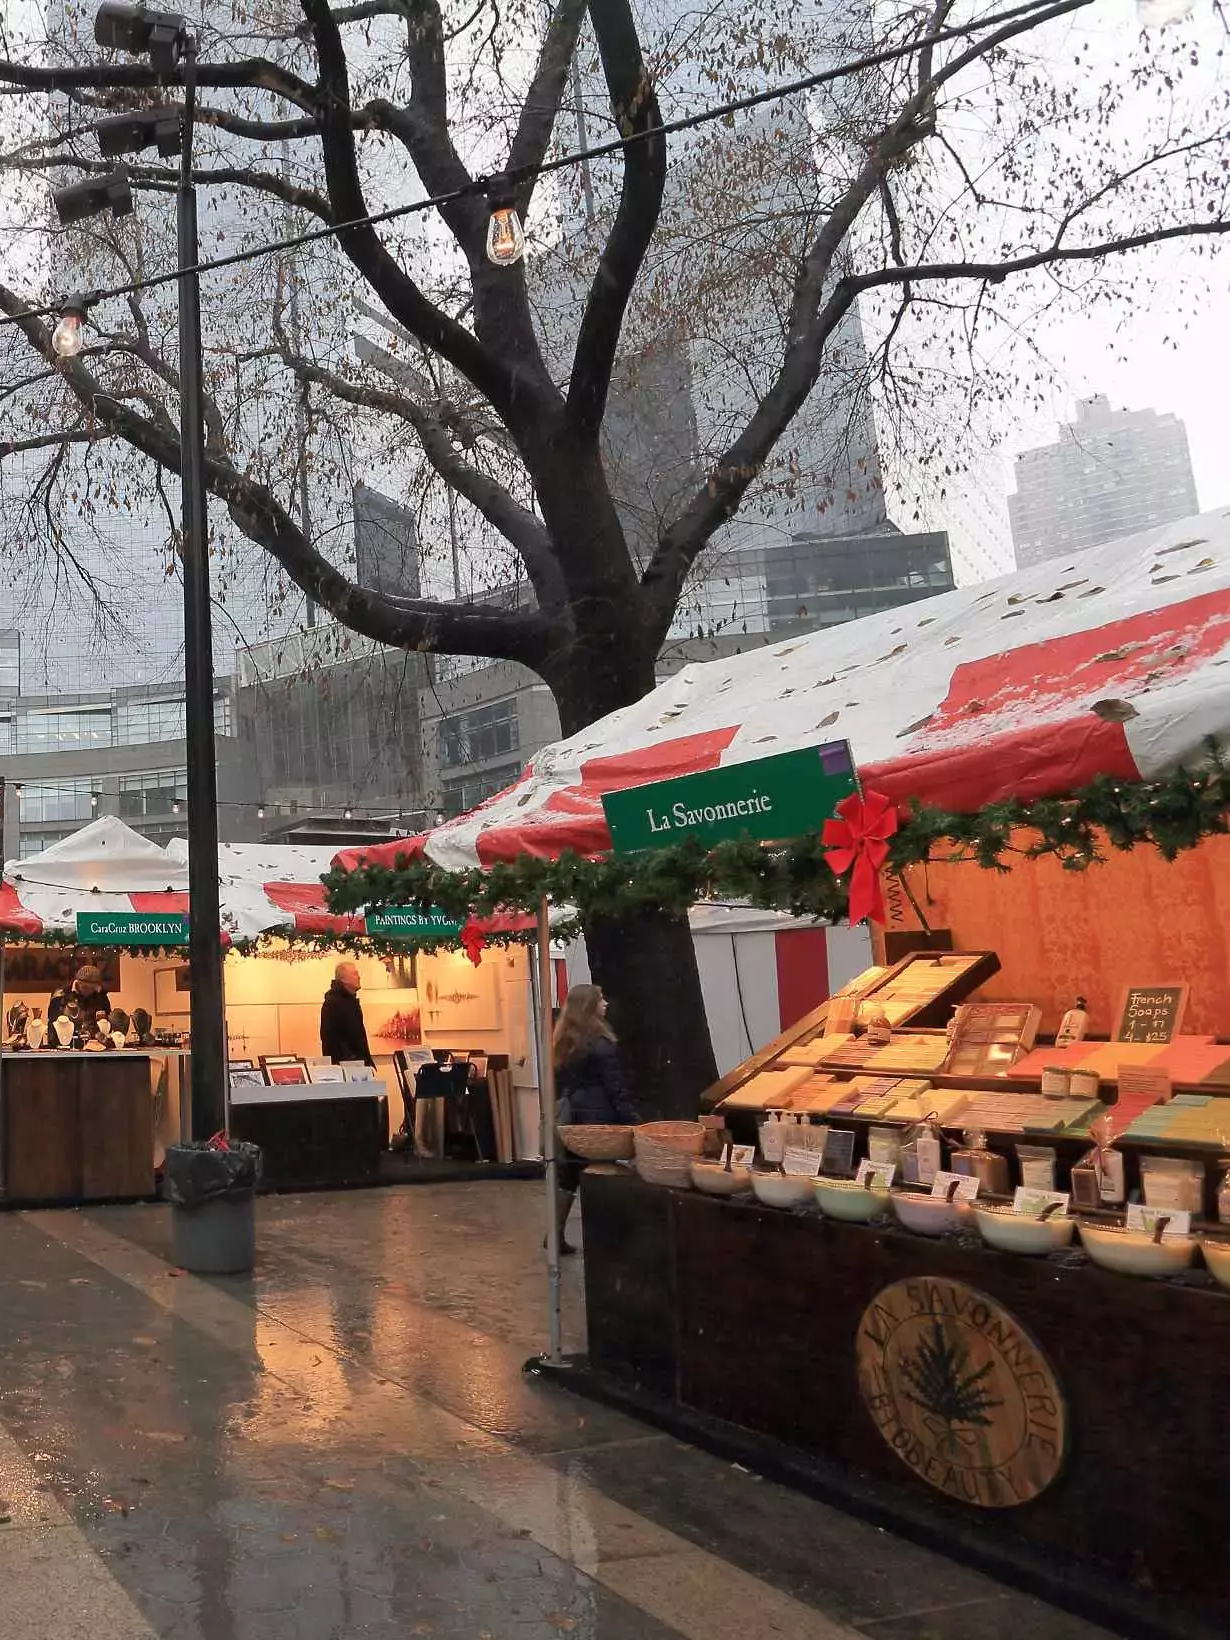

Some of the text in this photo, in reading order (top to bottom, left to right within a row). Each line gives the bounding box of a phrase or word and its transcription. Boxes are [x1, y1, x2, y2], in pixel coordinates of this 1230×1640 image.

[646, 794, 773, 832] La Savonnerie
[375, 915, 417, 926] PAINTINGS
[90, 922, 182, 934] CaraCruz BROOKLYN
[1130, 992, 1172, 1005] French
[864, 1280, 1058, 1460] LA SAVONNERIE
